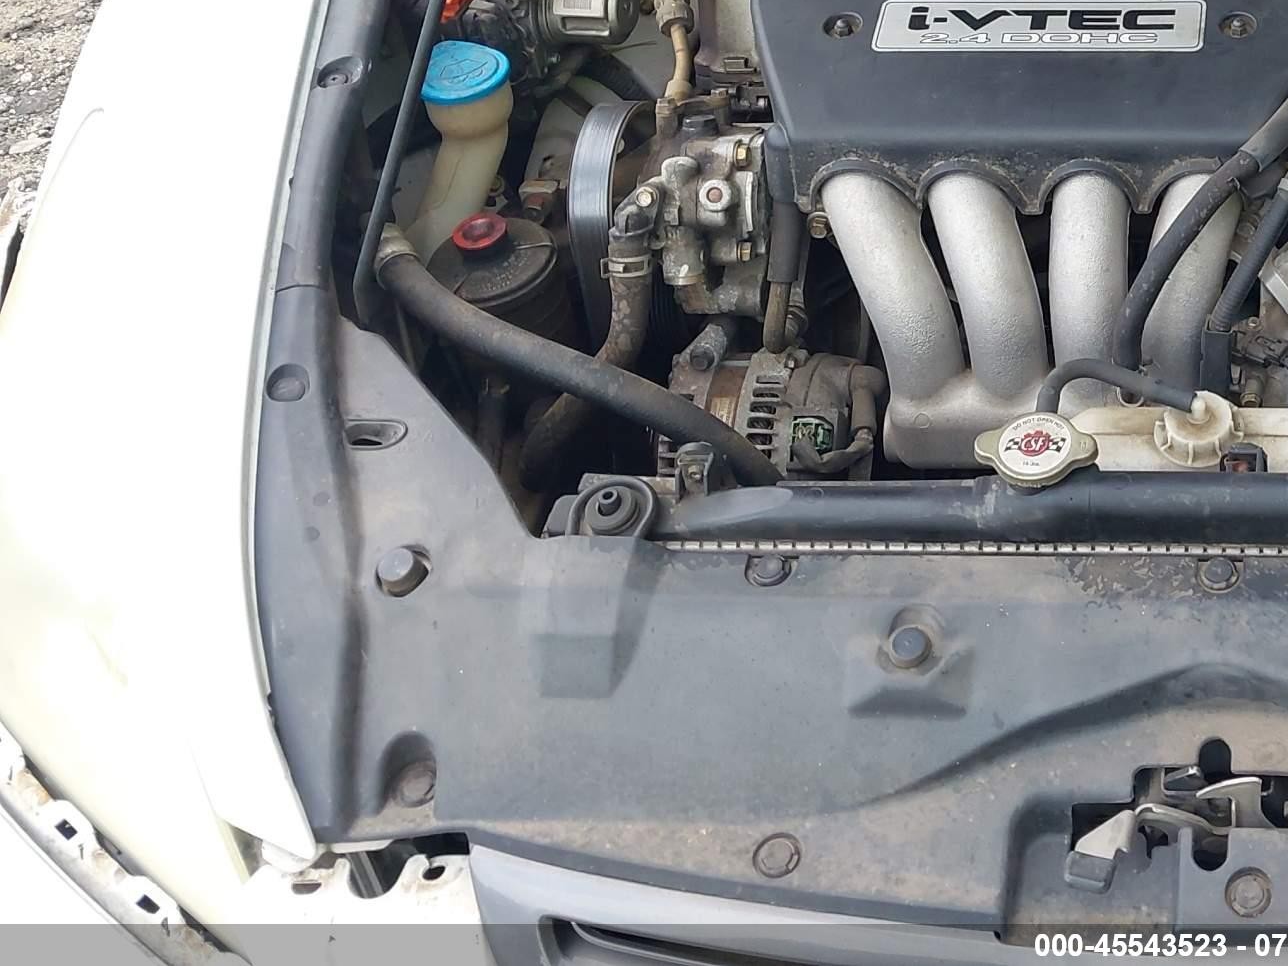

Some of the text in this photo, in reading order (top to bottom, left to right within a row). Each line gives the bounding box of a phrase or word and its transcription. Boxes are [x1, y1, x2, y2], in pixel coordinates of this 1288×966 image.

[908, 6, 1176, 31] i-VTEC
[919, 33, 1158, 44] 2.4 DOHC
[1022, 417, 1035, 425] NOT
[1021, 436, 1046, 451] CSF
